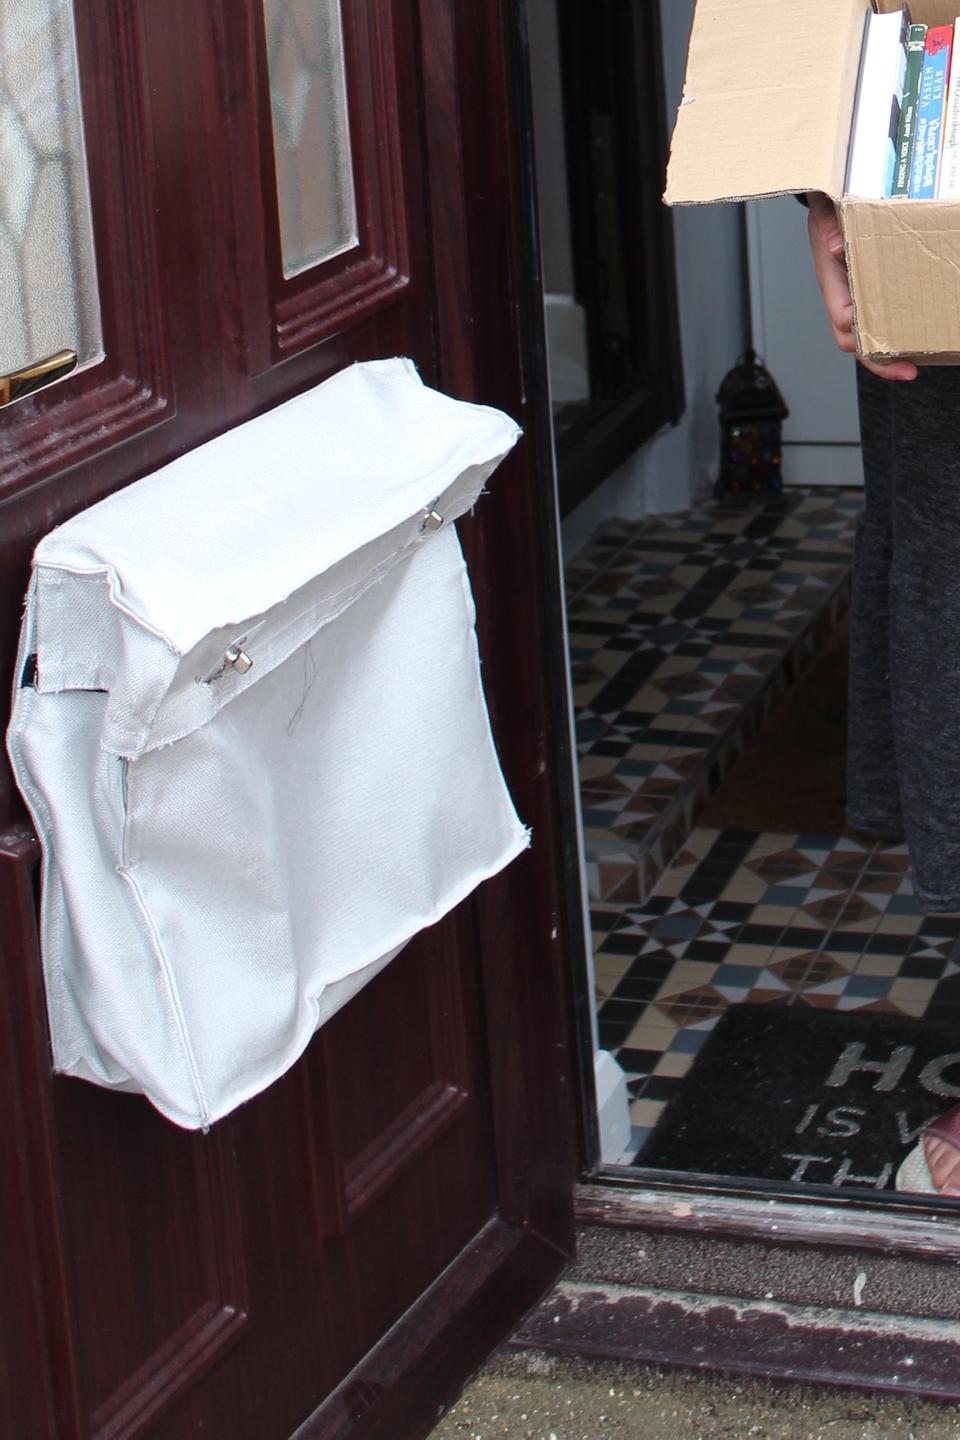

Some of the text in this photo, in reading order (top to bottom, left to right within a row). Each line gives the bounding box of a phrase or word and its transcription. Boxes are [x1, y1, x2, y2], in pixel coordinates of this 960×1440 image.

[921, 66, 934, 107] VASEEM
[933, 69, 944, 100] KHAN
[794, 1103, 867, 1138] IS
[781, 1152, 894, 1190] TH
